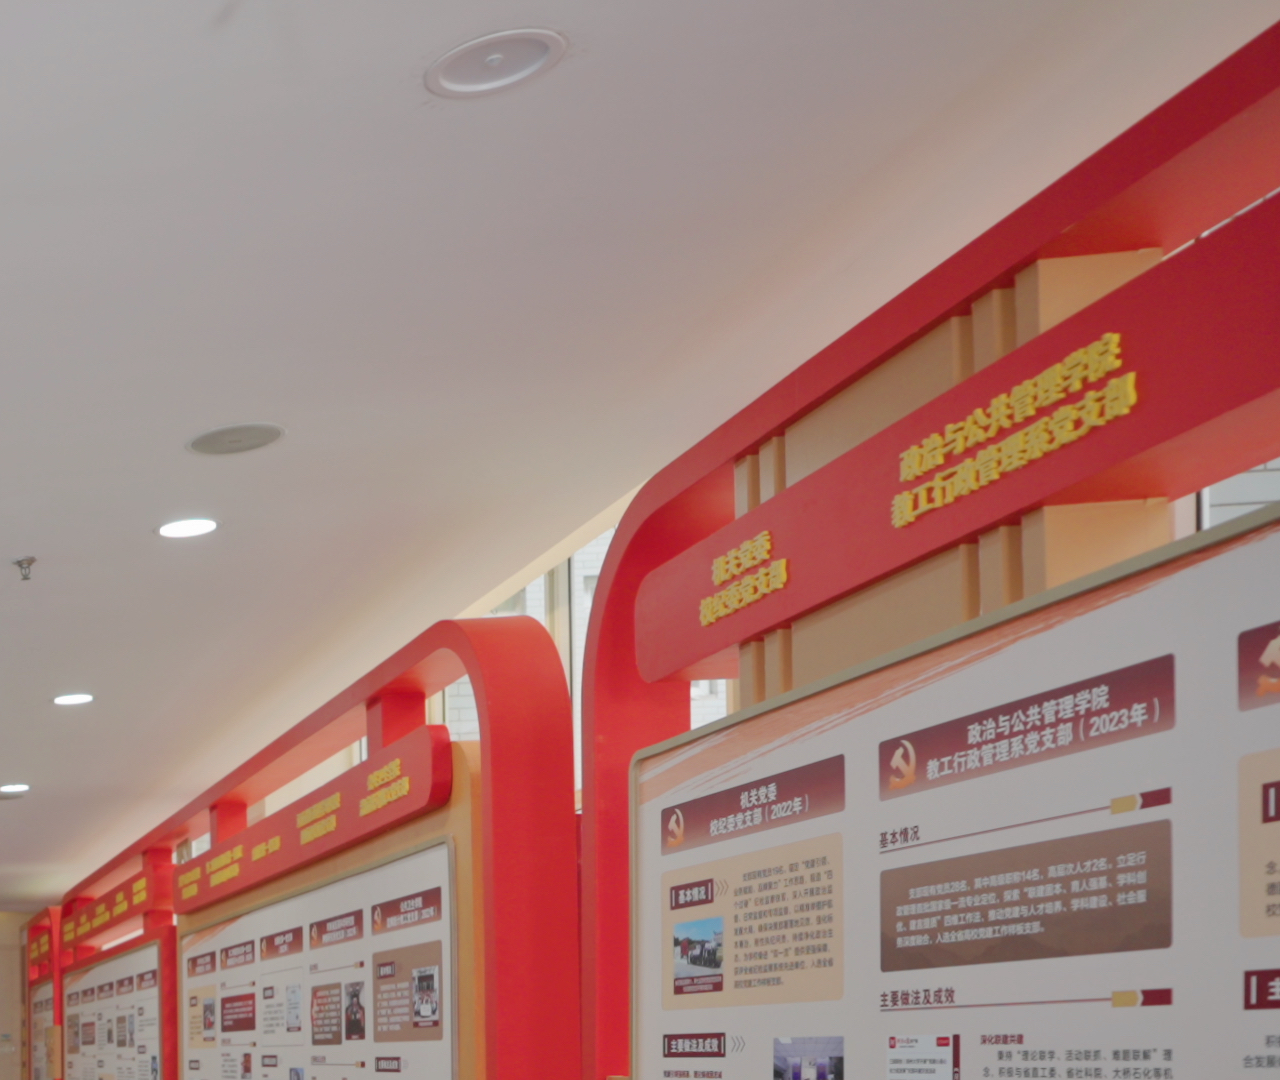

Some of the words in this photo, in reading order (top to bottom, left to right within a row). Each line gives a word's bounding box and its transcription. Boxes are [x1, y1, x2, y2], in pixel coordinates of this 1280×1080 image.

[899, 332, 1122, 482] 政治与公共管理学院
[891, 371, 1137, 528] 教工行政管理系党支部
[711, 530, 772, 587] 机关党委
[967, 684, 1110, 745] 政治与公共管理学院
[926, 697, 1160, 780] 教工行政管理系党支部（2023年）
[709, 793, 810, 837] 校纪委党支部（2022年）
[740, 782, 777, 808] 机关党委
[879, 825, 920, 848] 基本情况
[678, 886, 707, 905] 基本情况
[880, 987, 955, 1008] 主要做法及成效
[671, 1038, 718, 1053] 主要做法及成效
